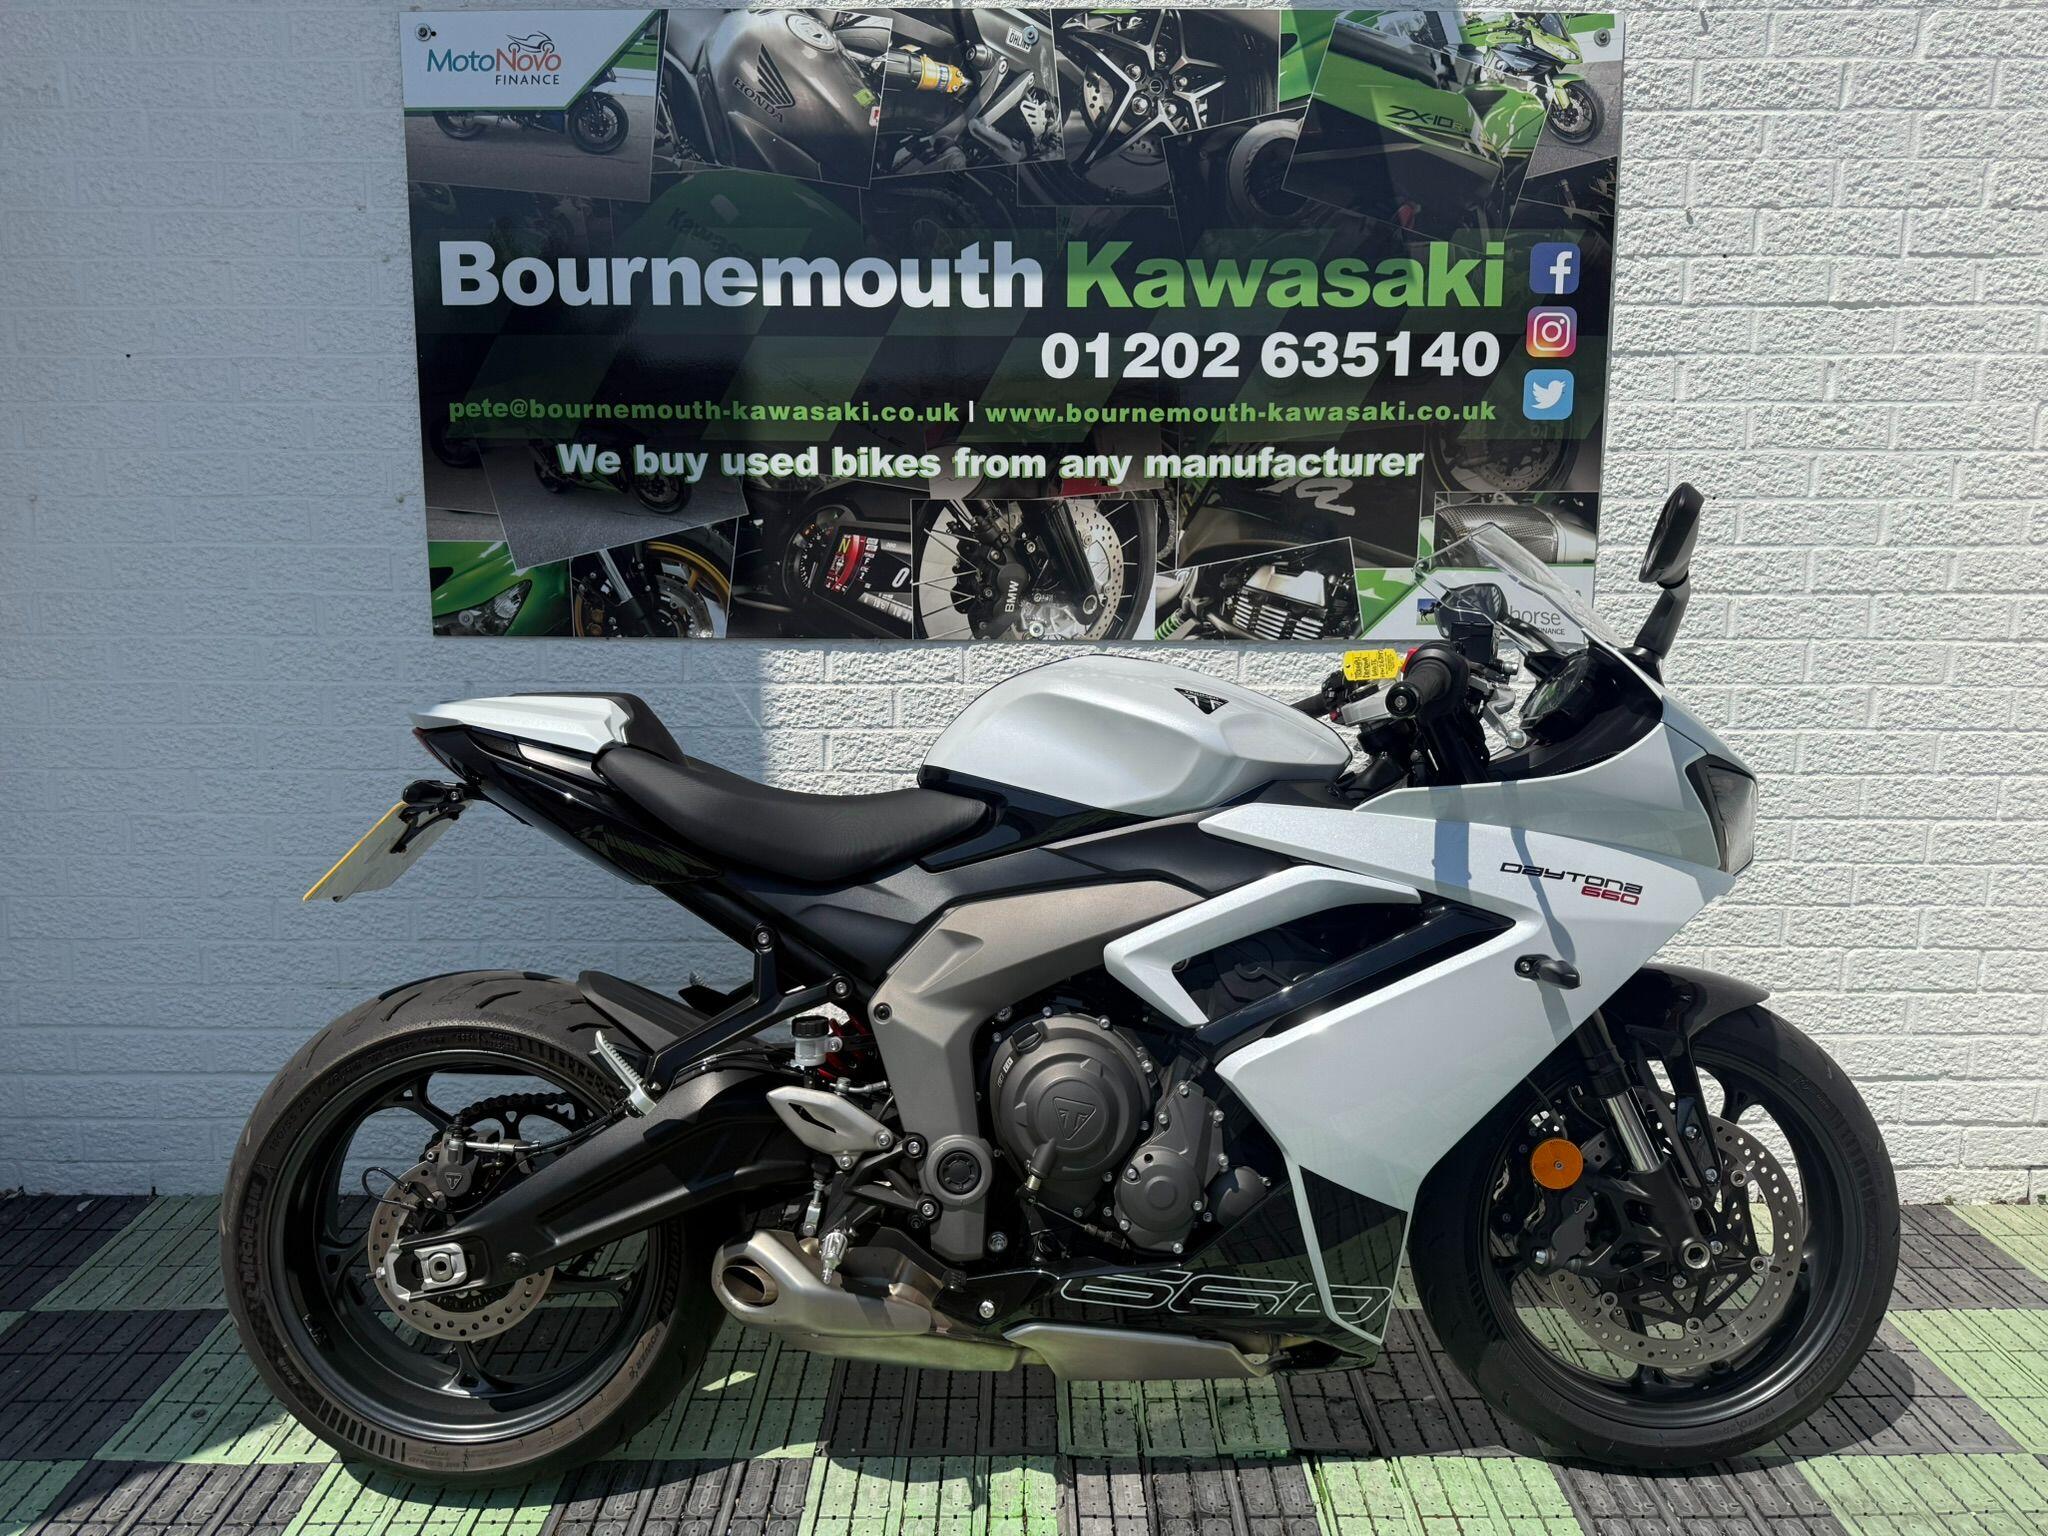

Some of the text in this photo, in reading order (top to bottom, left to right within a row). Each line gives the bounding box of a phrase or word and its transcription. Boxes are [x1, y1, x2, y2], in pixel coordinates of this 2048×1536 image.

[426, 48, 562, 72] MotoNovo
[495, 74, 560, 85] FINANCE
[732, 76, 785, 124] HONDA
[440, 241, 1505, 309] Bournemouth Kawasaki
[1041, 331, 1500, 379] 01202 635140
[449, 399, 960, 424] pete@bournemouth-kawasaki.co.uk
[984, 400, 1497, 424] www.bournemouth-kawasaki.co.uk
[557, 443, 1425, 486] We buy used bikes from any manufacturer
[1004, 580, 1019, 613] BMW
[1508, 604, 1561, 626] horse
[1581, 885, 1640, 906] 660
[239, 1180, 263, 1284] MICHELIN
